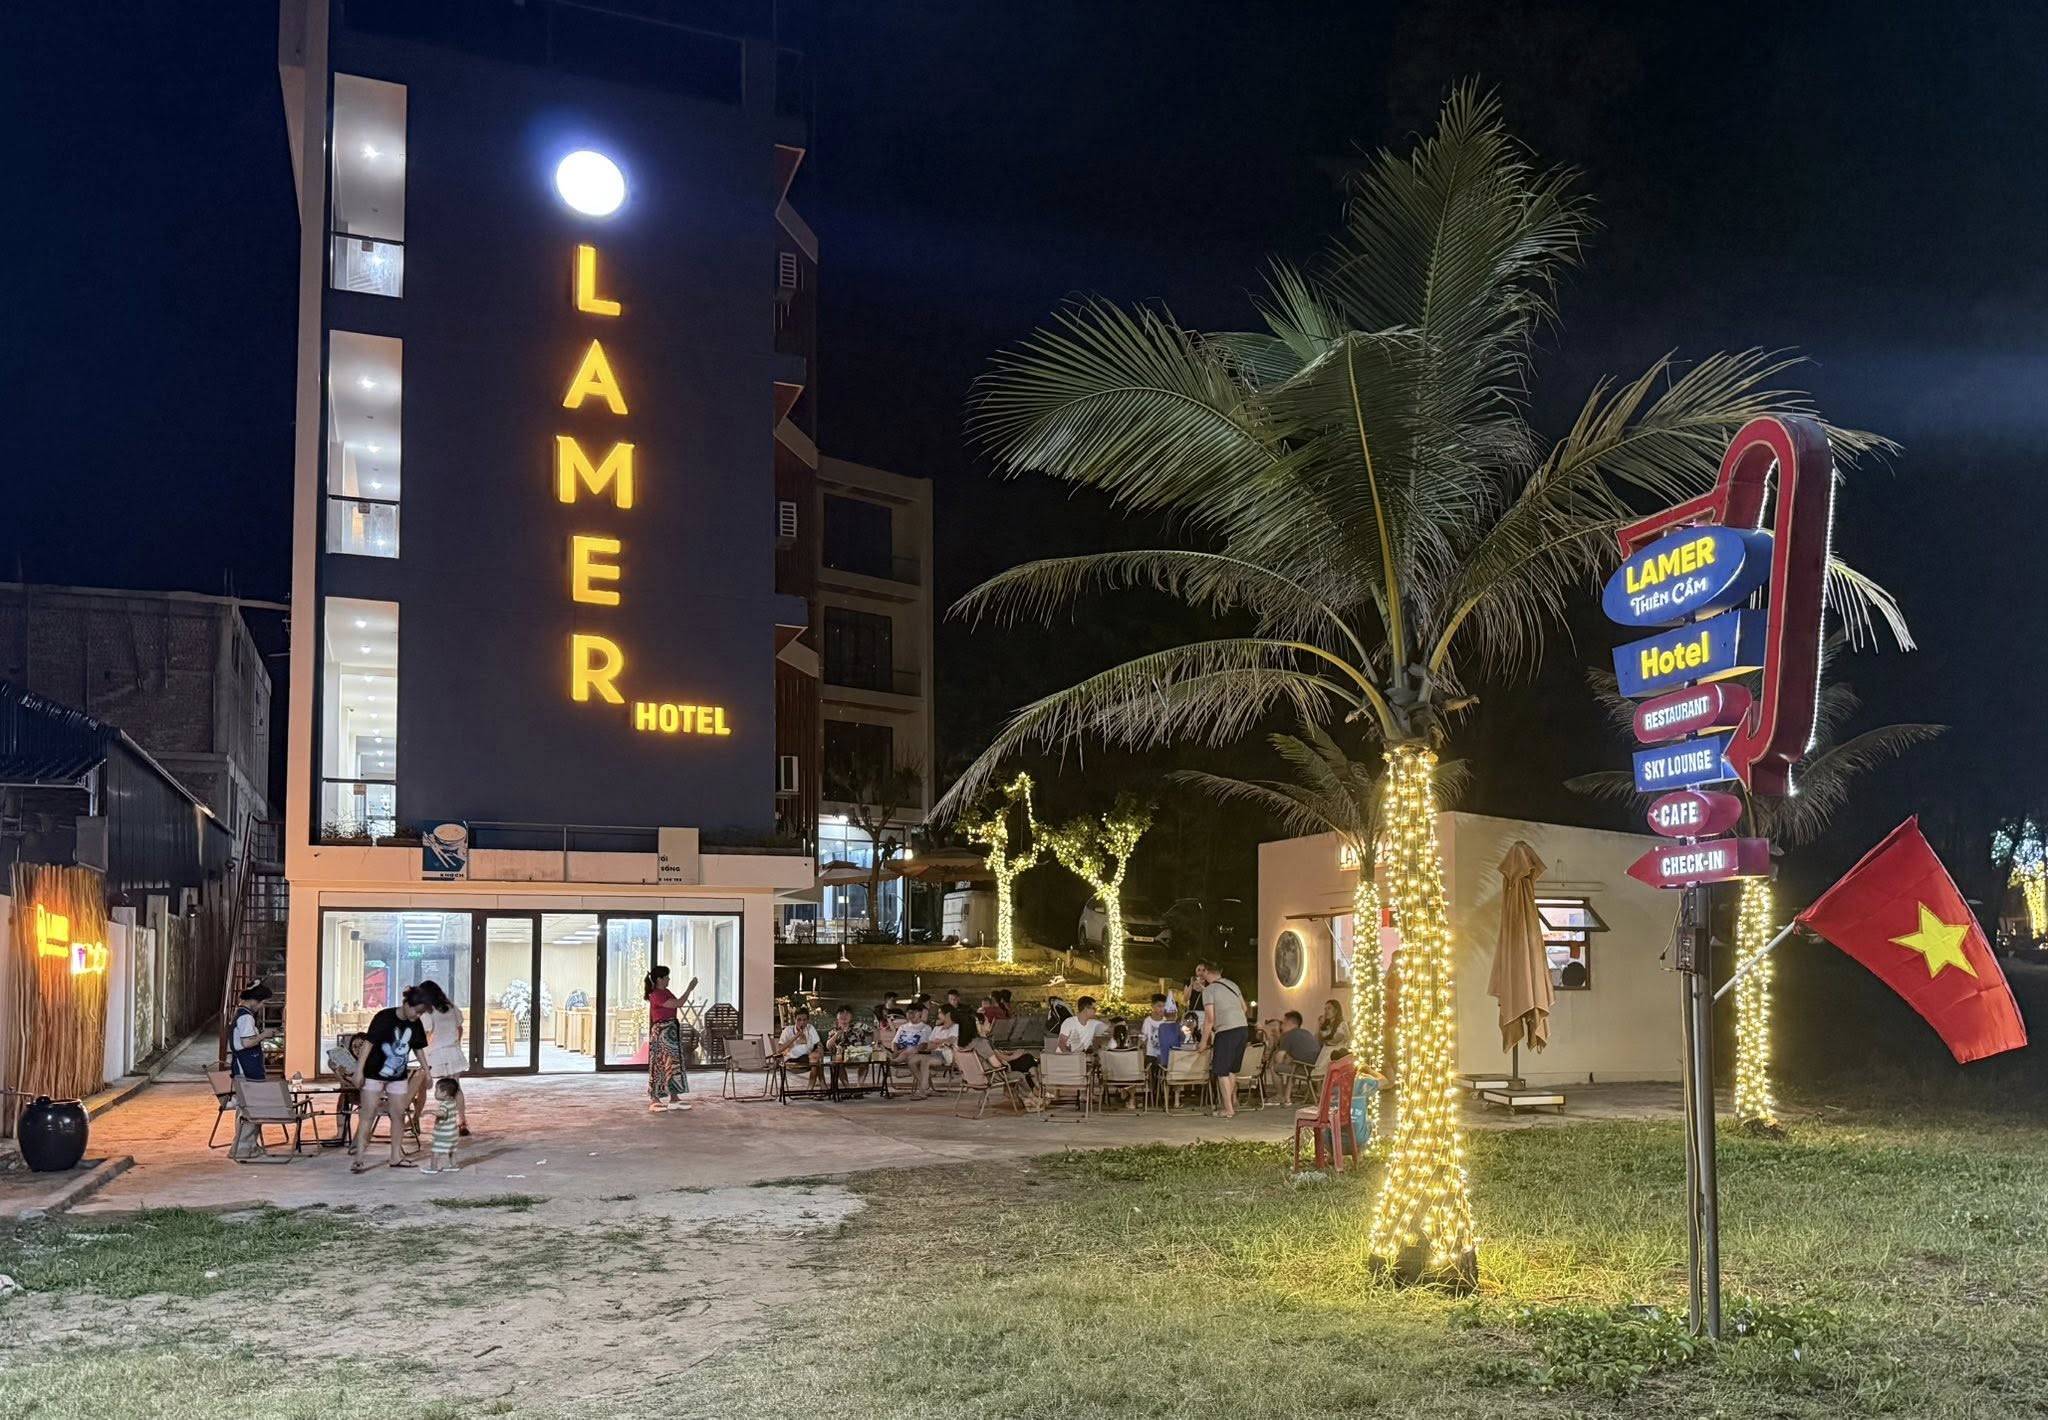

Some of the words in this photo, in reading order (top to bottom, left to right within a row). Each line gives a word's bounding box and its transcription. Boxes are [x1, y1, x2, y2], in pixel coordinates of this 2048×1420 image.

[556, 244, 635, 705] LAMER
[1626, 536, 1715, 594] LAMER
[1630, 591, 1669, 616] THIÊN
[1641, 631, 1709, 680] Hotel
[636, 702, 731, 735] HOTEL
[1644, 696, 1710, 731] RESTAURANT
[1644, 761, 1666, 781] SKY
[1667, 749, 1712, 777] LOUNGE
[1660, 801, 1699, 828] CAFE
[1661, 849, 1725, 877] CHECK-IN
